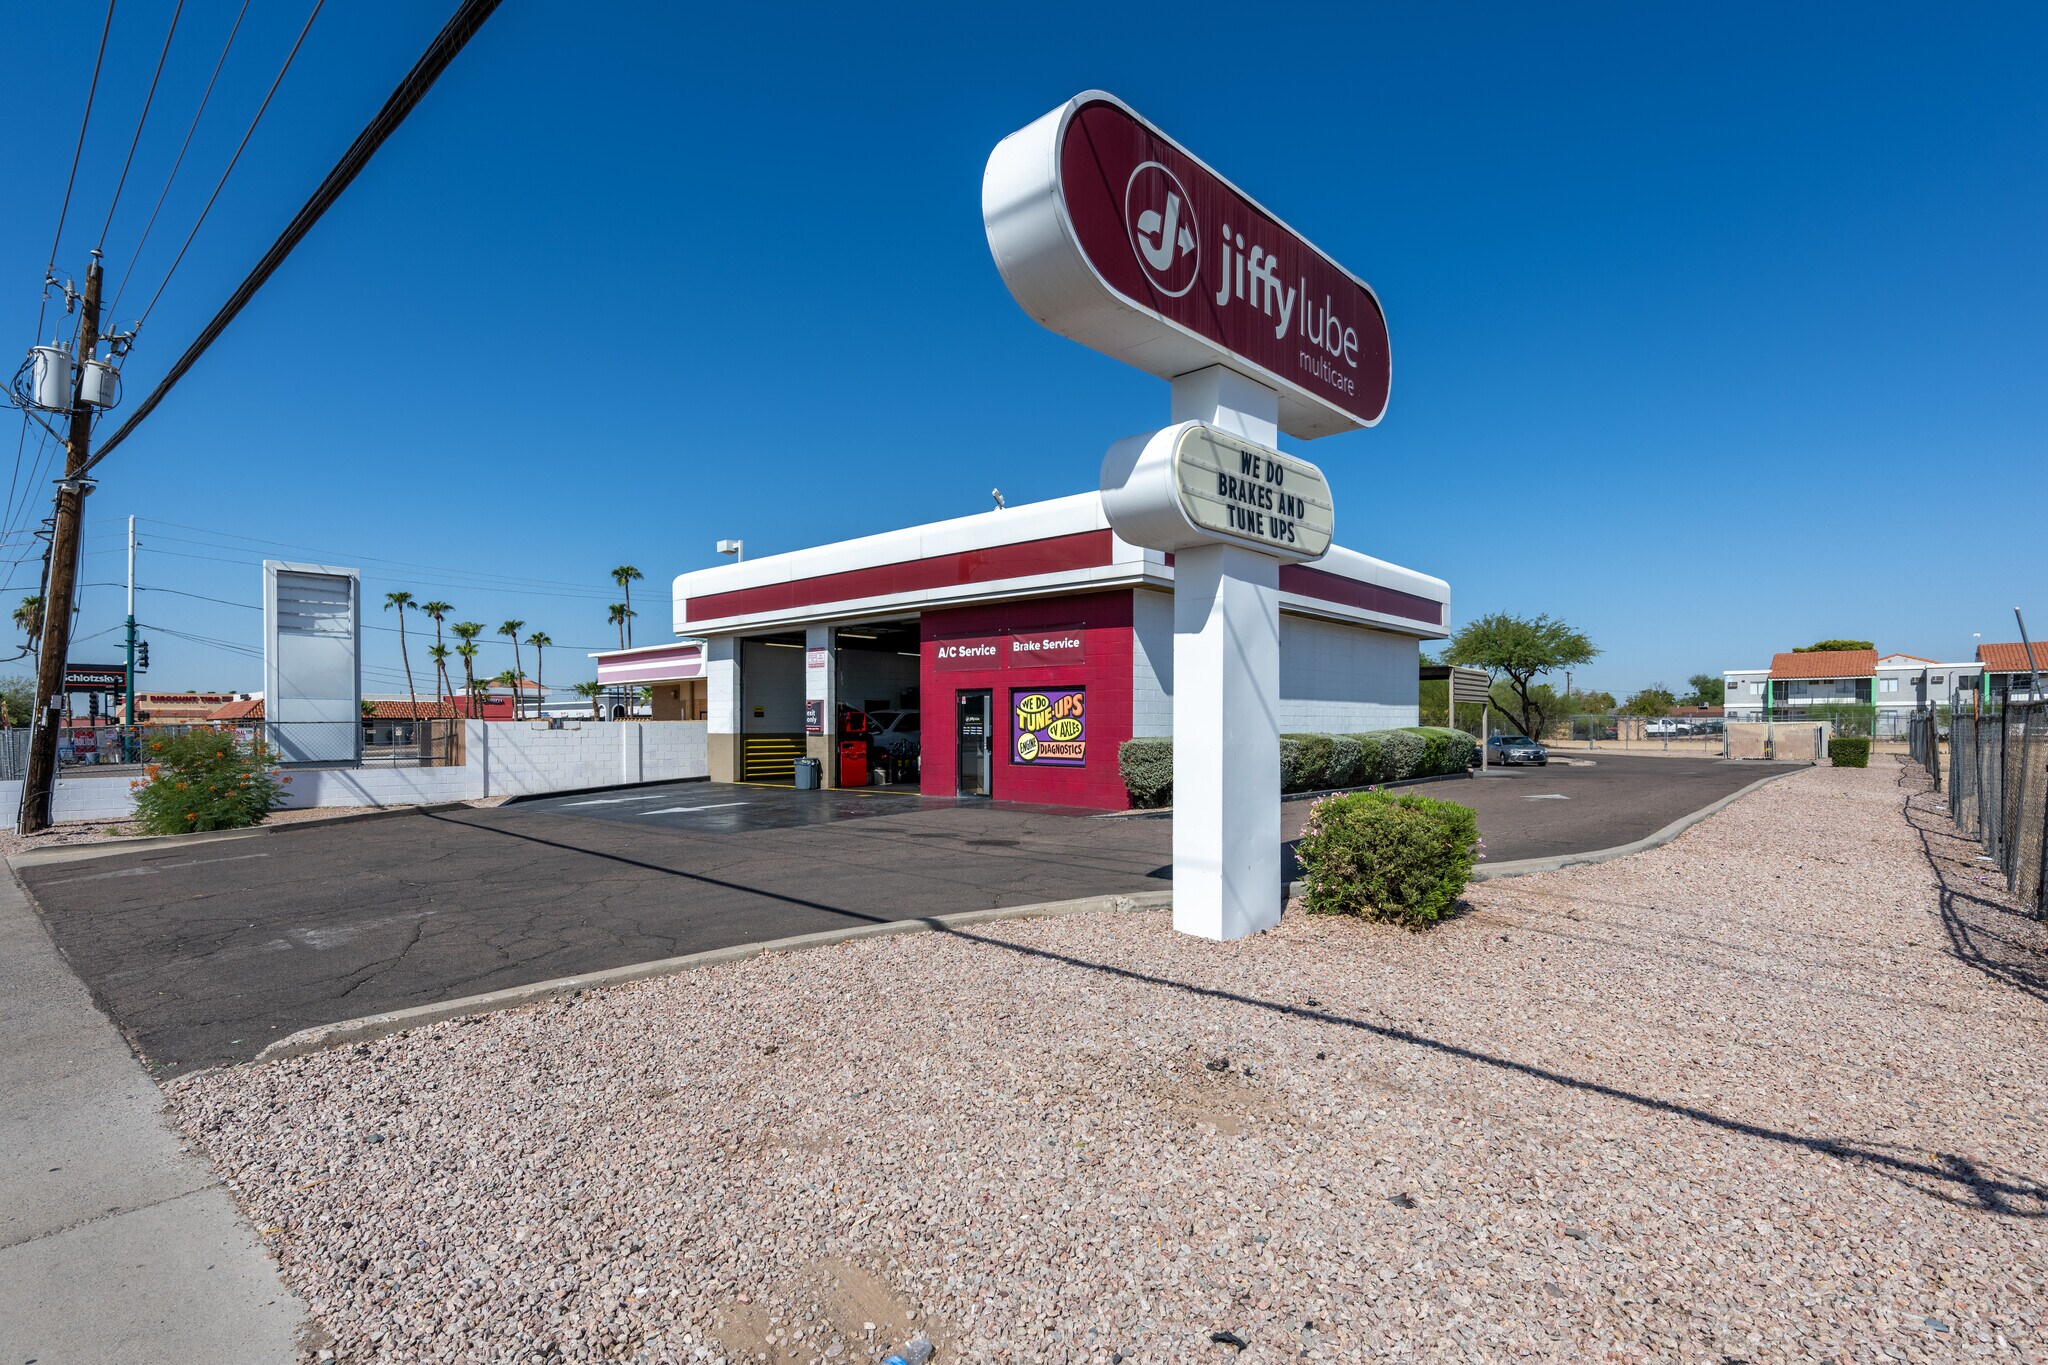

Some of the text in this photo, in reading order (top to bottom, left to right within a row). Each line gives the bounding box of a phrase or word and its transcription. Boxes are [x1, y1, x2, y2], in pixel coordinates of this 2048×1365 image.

[1216, 223, 1359, 368] jiffy lube
[1299, 350, 1355, 397] multicare
[1241, 450, 1284, 487] WE DO
[1218, 472, 1305, 520] BRAKES AND
[1227, 504, 1295, 543] TUNE UPS
[938, 644, 996, 659] A/C Service
[1013, 637, 1080, 652] Brake Service
[1022, 696, 1047, 710] WE DO
[807, 716, 817, 724] only
[1060, 721, 1080, 738] AXLES
[1019, 737, 1036, 754] ENGINE
[1040, 743, 1083, 756] DIAGNOSTICS
